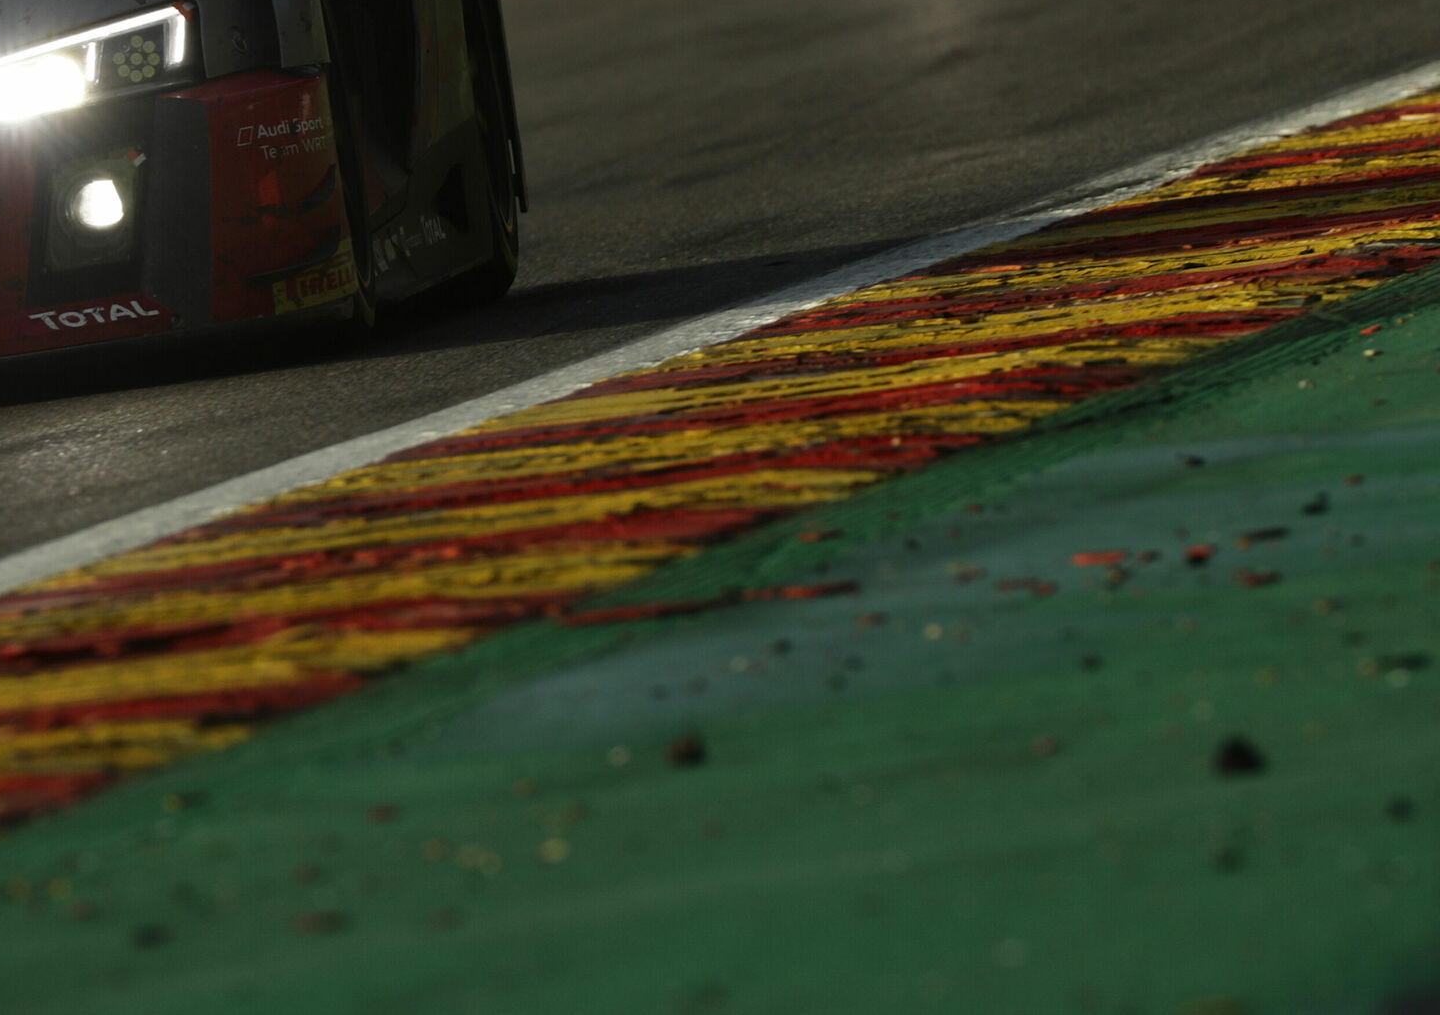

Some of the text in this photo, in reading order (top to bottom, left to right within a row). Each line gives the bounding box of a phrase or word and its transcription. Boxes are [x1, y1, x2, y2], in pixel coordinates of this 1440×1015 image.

[257, 116, 325, 139] Audi Sport
[302, 136, 327, 153] WRT
[28, 300, 161, 330] TOTAL
